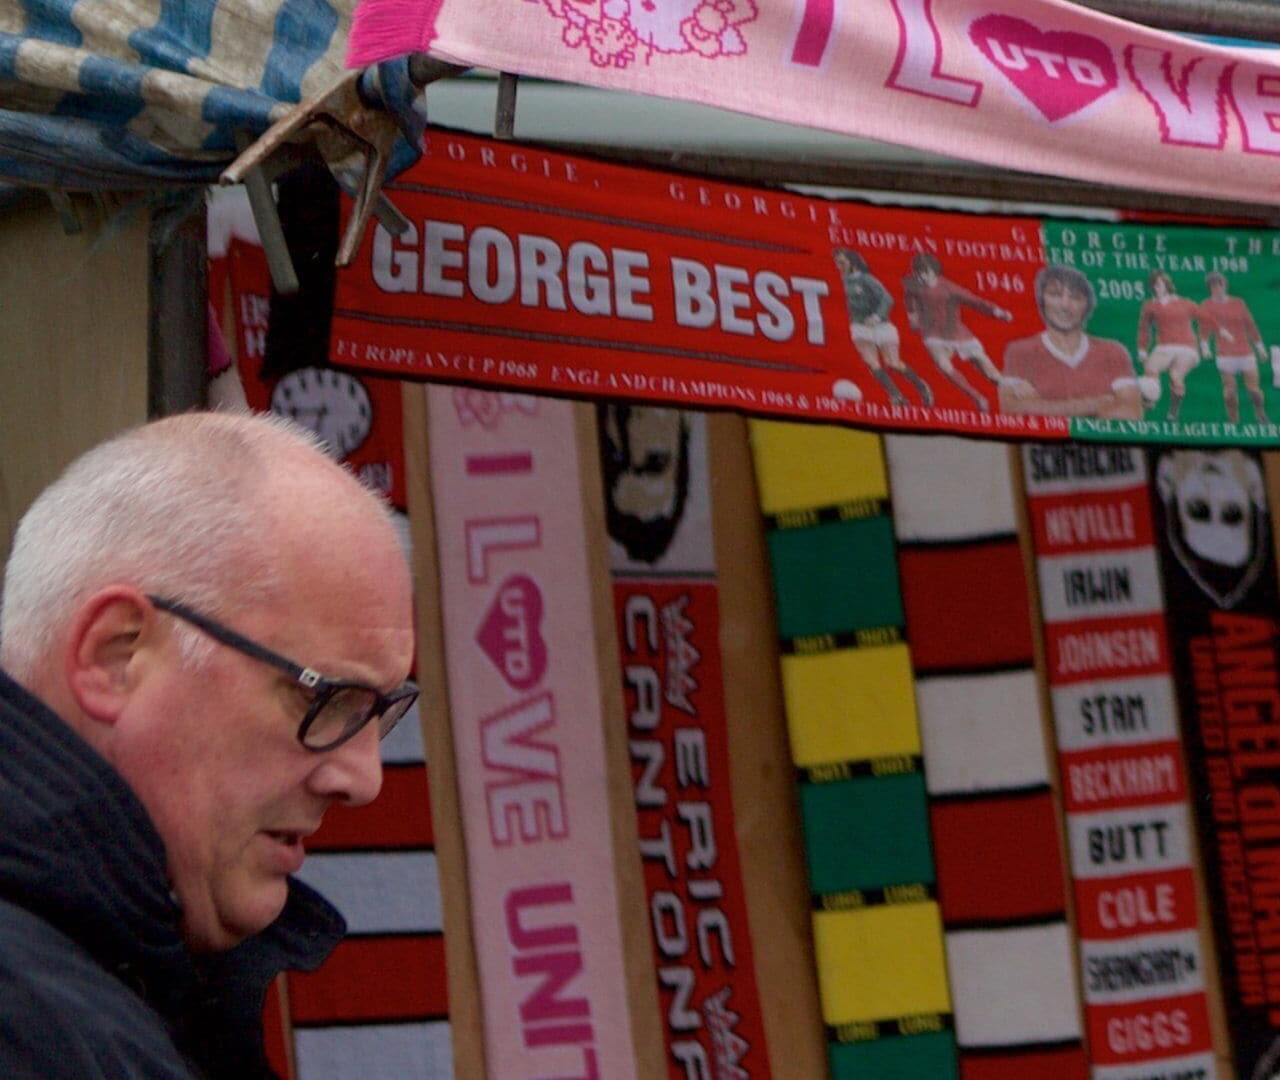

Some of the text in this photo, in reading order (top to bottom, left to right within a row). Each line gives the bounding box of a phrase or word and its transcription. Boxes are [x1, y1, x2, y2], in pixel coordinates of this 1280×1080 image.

[986, 36, 1105, 90] UTD
[667, 181, 843, 226] GEORGIE
[828, 225, 1249, 274] EUROPEAN FOOTBALLER OF THE YEAR 1968
[372, 218, 831, 347] GEORGE BEST
[974, 270, 1146, 300] 1946 2005
[336, 339, 451, 370] EUROPEAN
[453, 350, 496, 374] CUP
[498, 358, 539, 380] 1968
[550, 365, 649, 393] ENGLAND
[648, 375, 757, 402] CHAMPIONS
[1073, 417, 1160, 437] ENGLAND'S
[1161, 420, 1223, 439] LEAGUE
[1223, 422, 1278, 440] PLAYER
[1043, 503, 1134, 542] NEVILLE
[1063, 568, 1133, 608] IRWIN
[1057, 630, 1160, 674] JOHNSEN
[1079, 697, 1147, 734] STAM
[1070, 758, 1177, 802] BECKHAM
[675, 726, 737, 971] ERIC
[1088, 822, 1170, 863] BUTT
[1098, 885, 1177, 930] COLE
[1107, 1010, 1191, 1056] GIGGS
